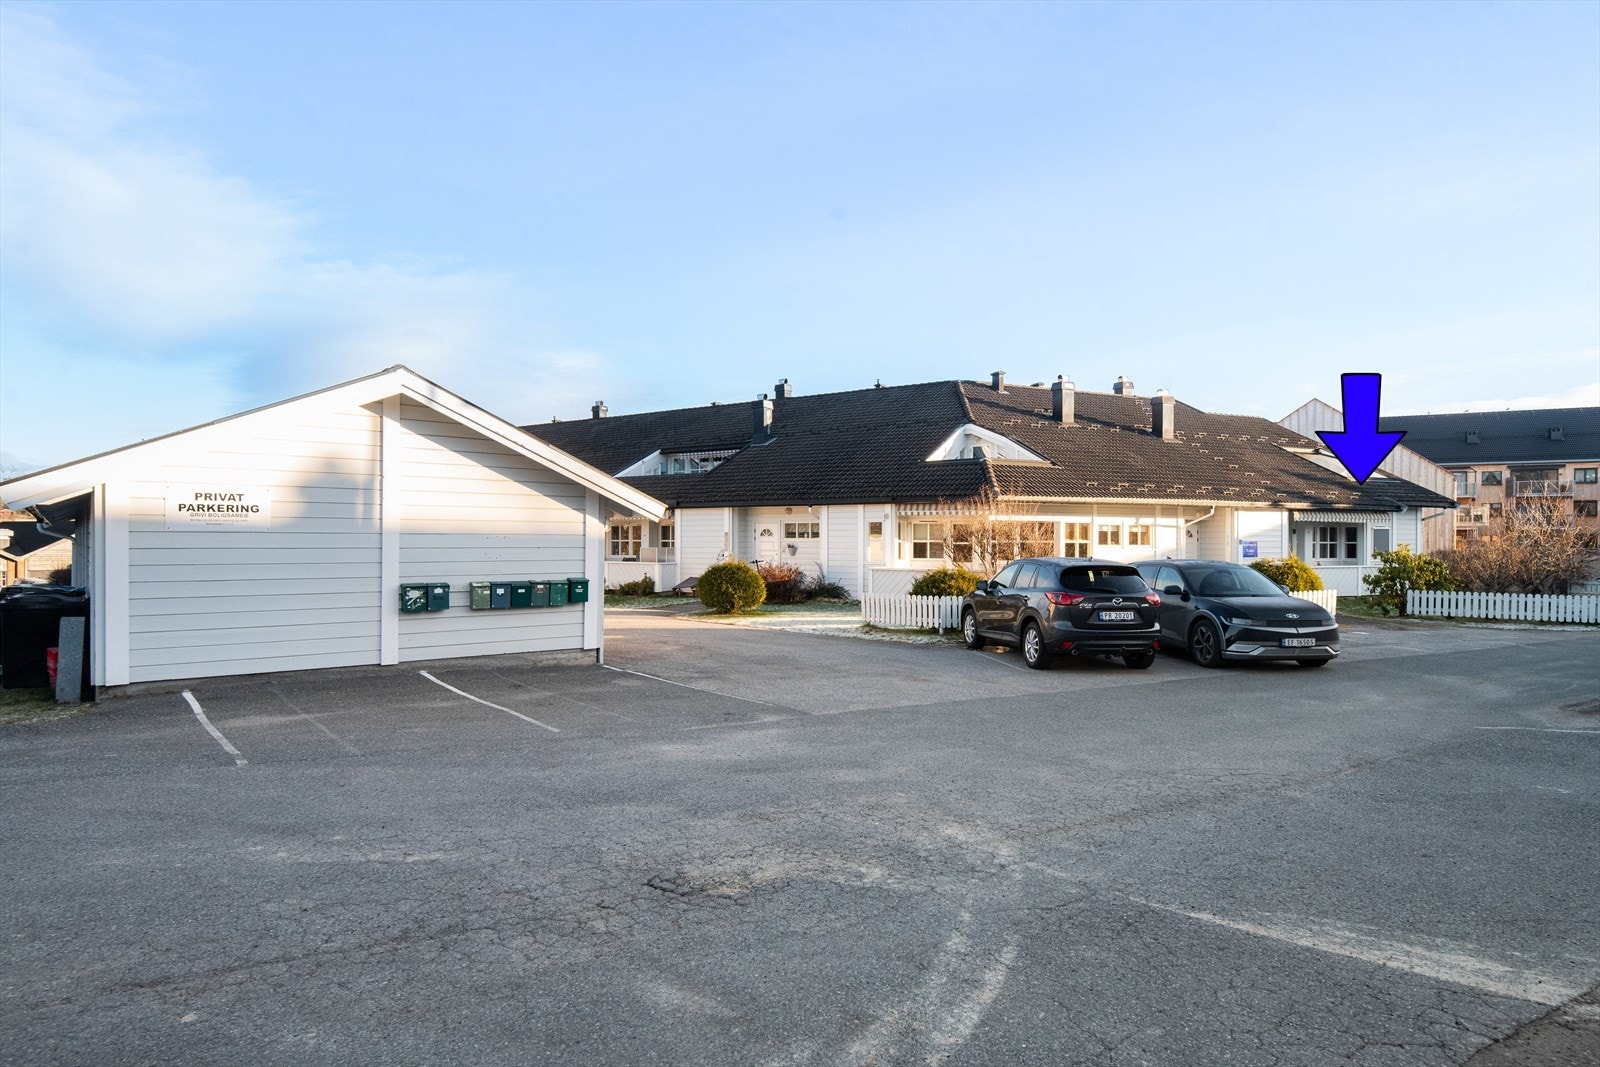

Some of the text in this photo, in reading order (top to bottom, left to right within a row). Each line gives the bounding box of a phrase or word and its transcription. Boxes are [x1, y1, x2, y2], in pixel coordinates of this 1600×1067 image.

[194, 492, 245, 502] PRIVAT
[178, 503, 260, 513] PARKERING
[1104, 611, 1133, 619] PR 20201
[1287, 639, 1295, 647] EF
